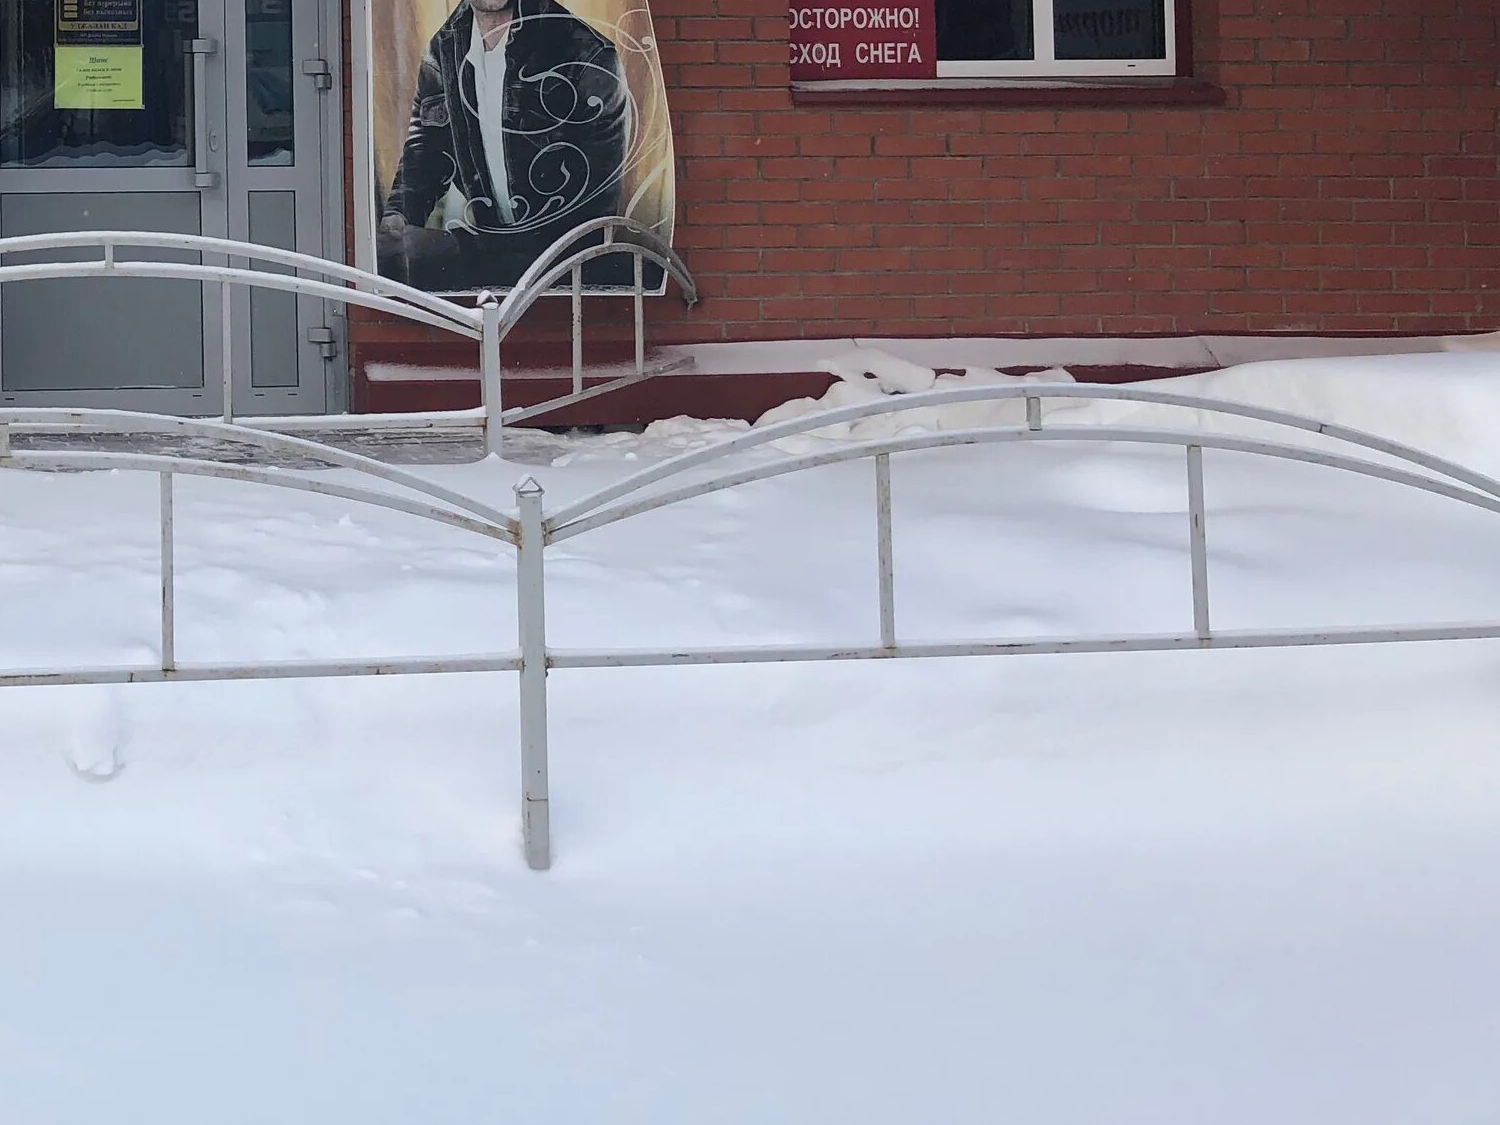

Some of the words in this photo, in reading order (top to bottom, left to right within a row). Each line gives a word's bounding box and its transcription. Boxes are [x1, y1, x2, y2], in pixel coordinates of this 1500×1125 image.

[789, 7, 920, 29] ОСТОРОЖНО!
[789, 43, 841, 67] СХОД
[855, 42, 923, 64] СНЕГА
